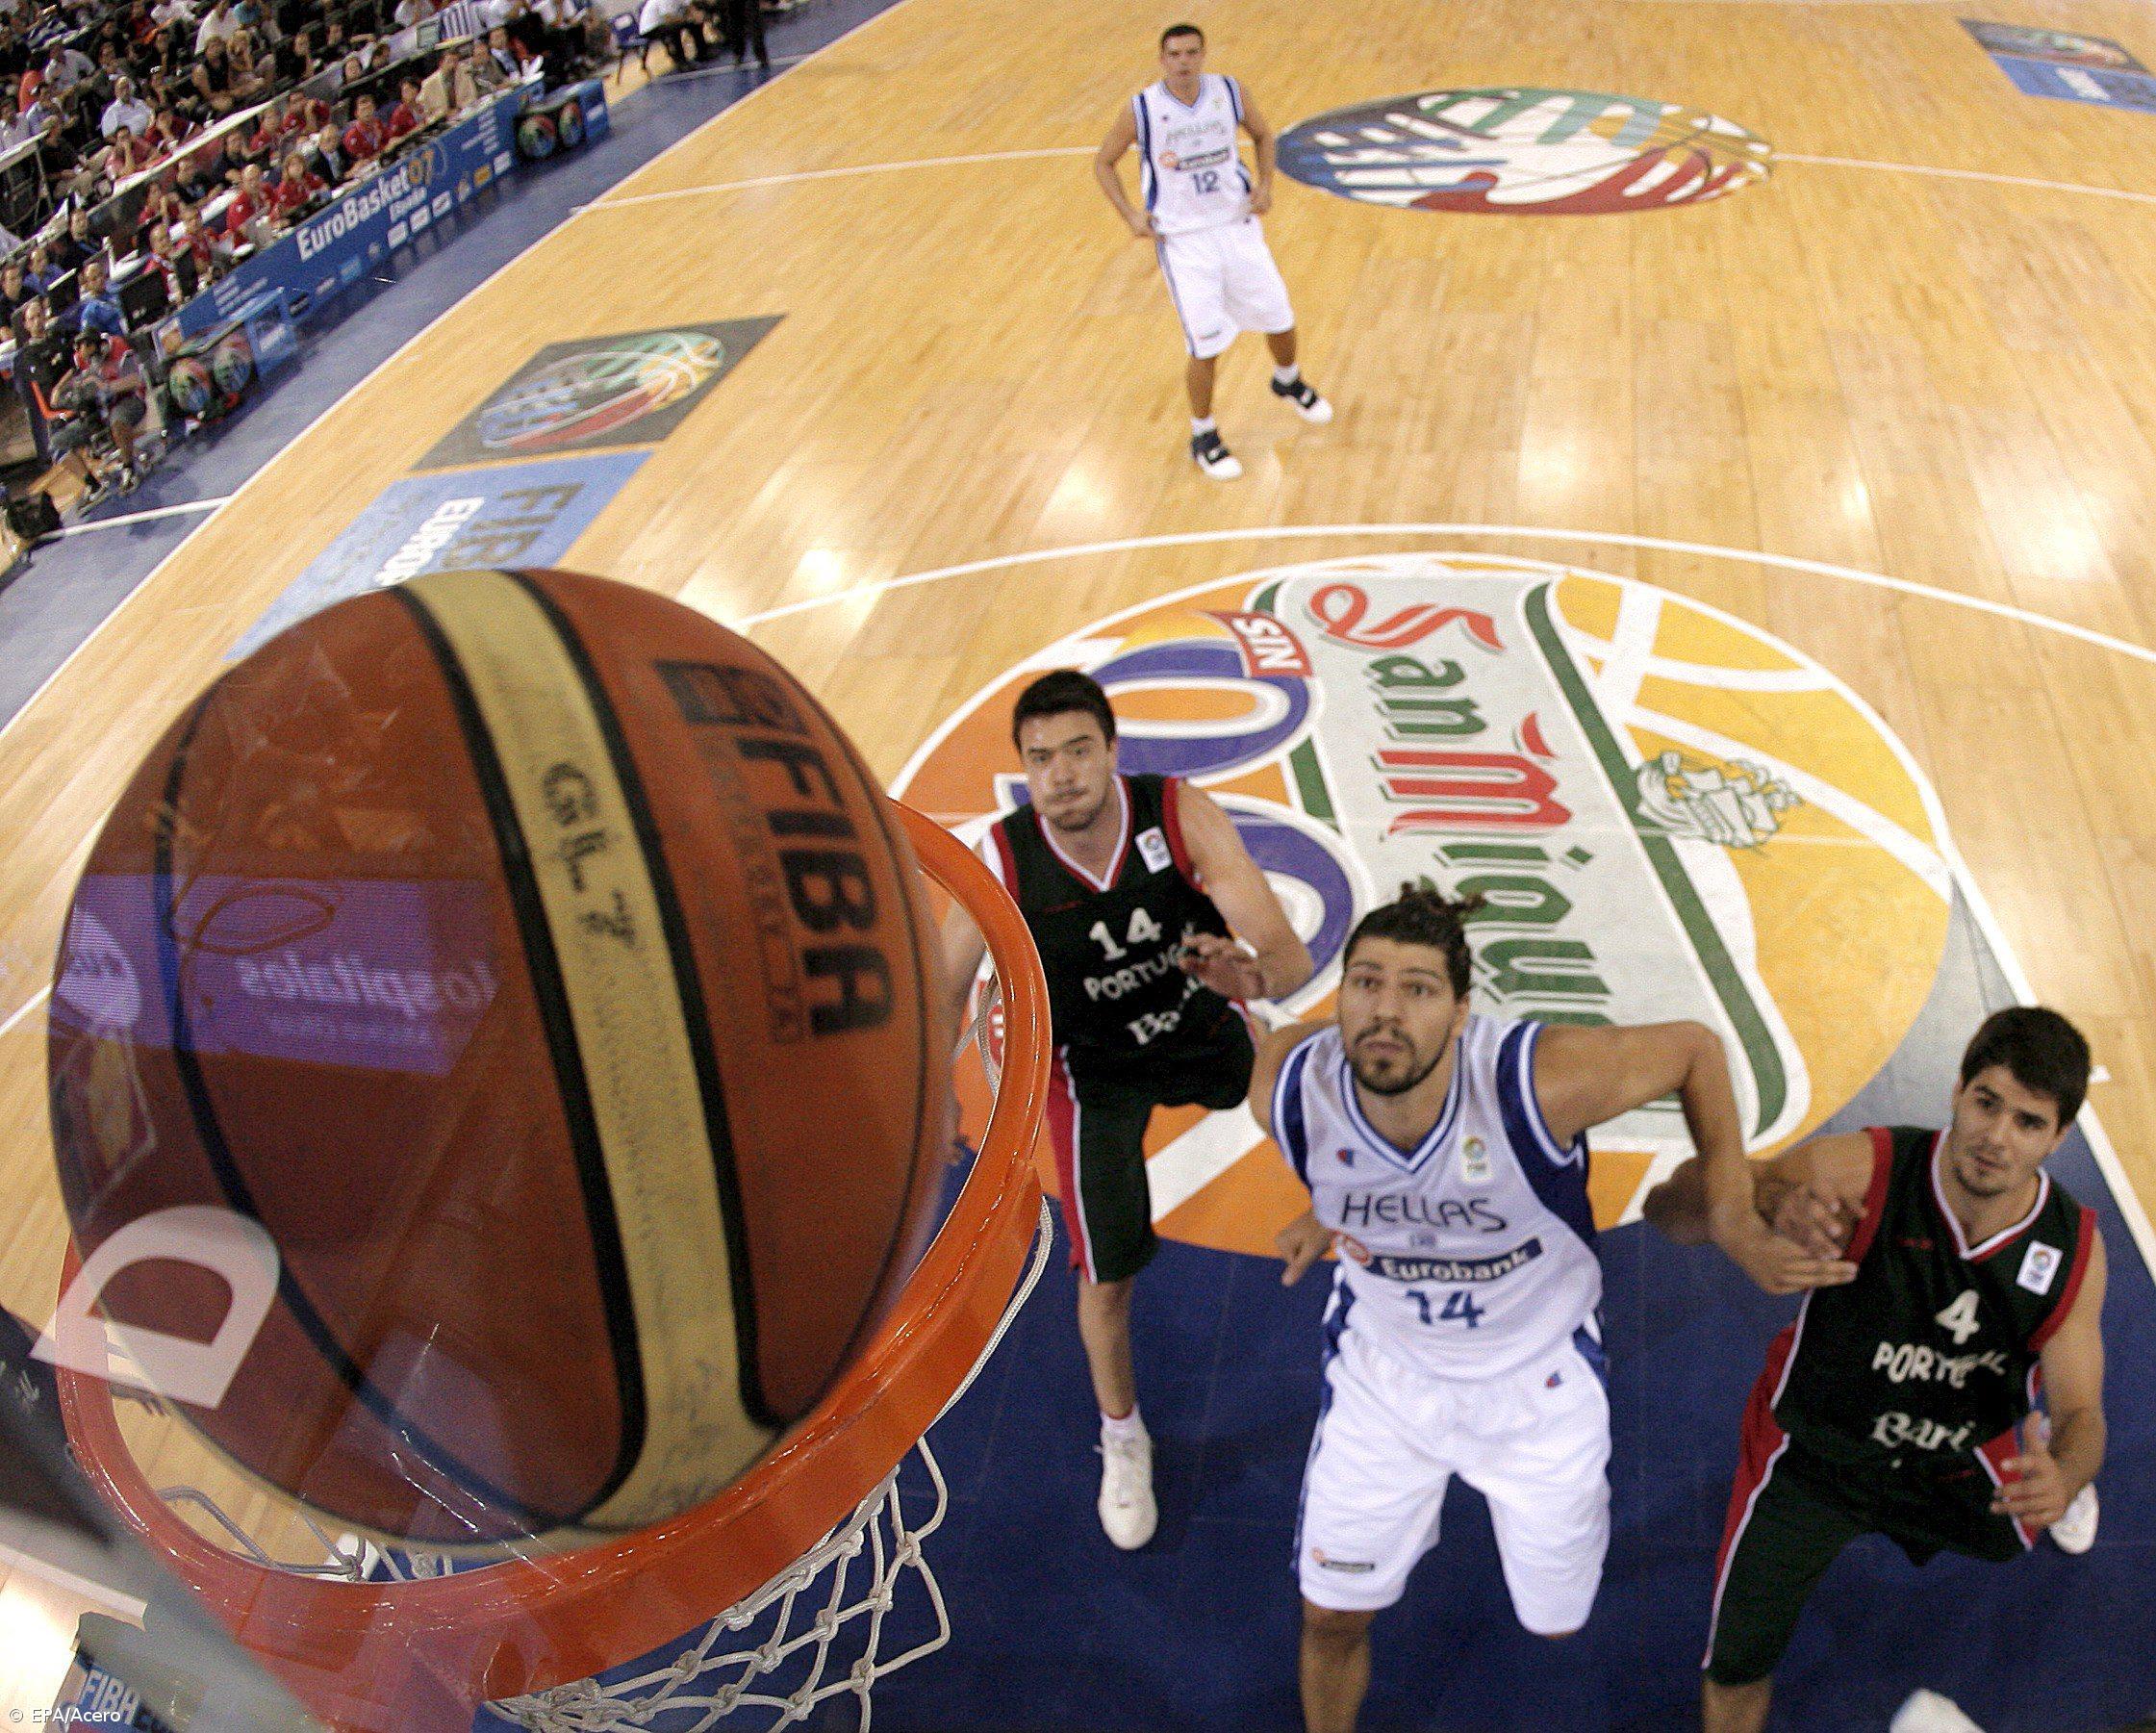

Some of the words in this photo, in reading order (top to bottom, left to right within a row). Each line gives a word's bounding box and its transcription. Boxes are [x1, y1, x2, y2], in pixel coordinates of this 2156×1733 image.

[1193, 170, 1220, 192] 12
[1231, 617, 1304, 671] SIN
[1308, 582, 1506, 736] San
[736, 735, 895, 1033] FIBA
[1089, 906, 1162, 961] 14
[1340, 1192, 1508, 1234] HELLAS
[1382, 1248, 1532, 1282] Eurobank
[29, 1205, 280, 1411] D
[1405, 1288, 1484, 1328] 14
[1935, 1289, 1980, 1344] 4
[79, 1669, 141, 1726] FIBA
